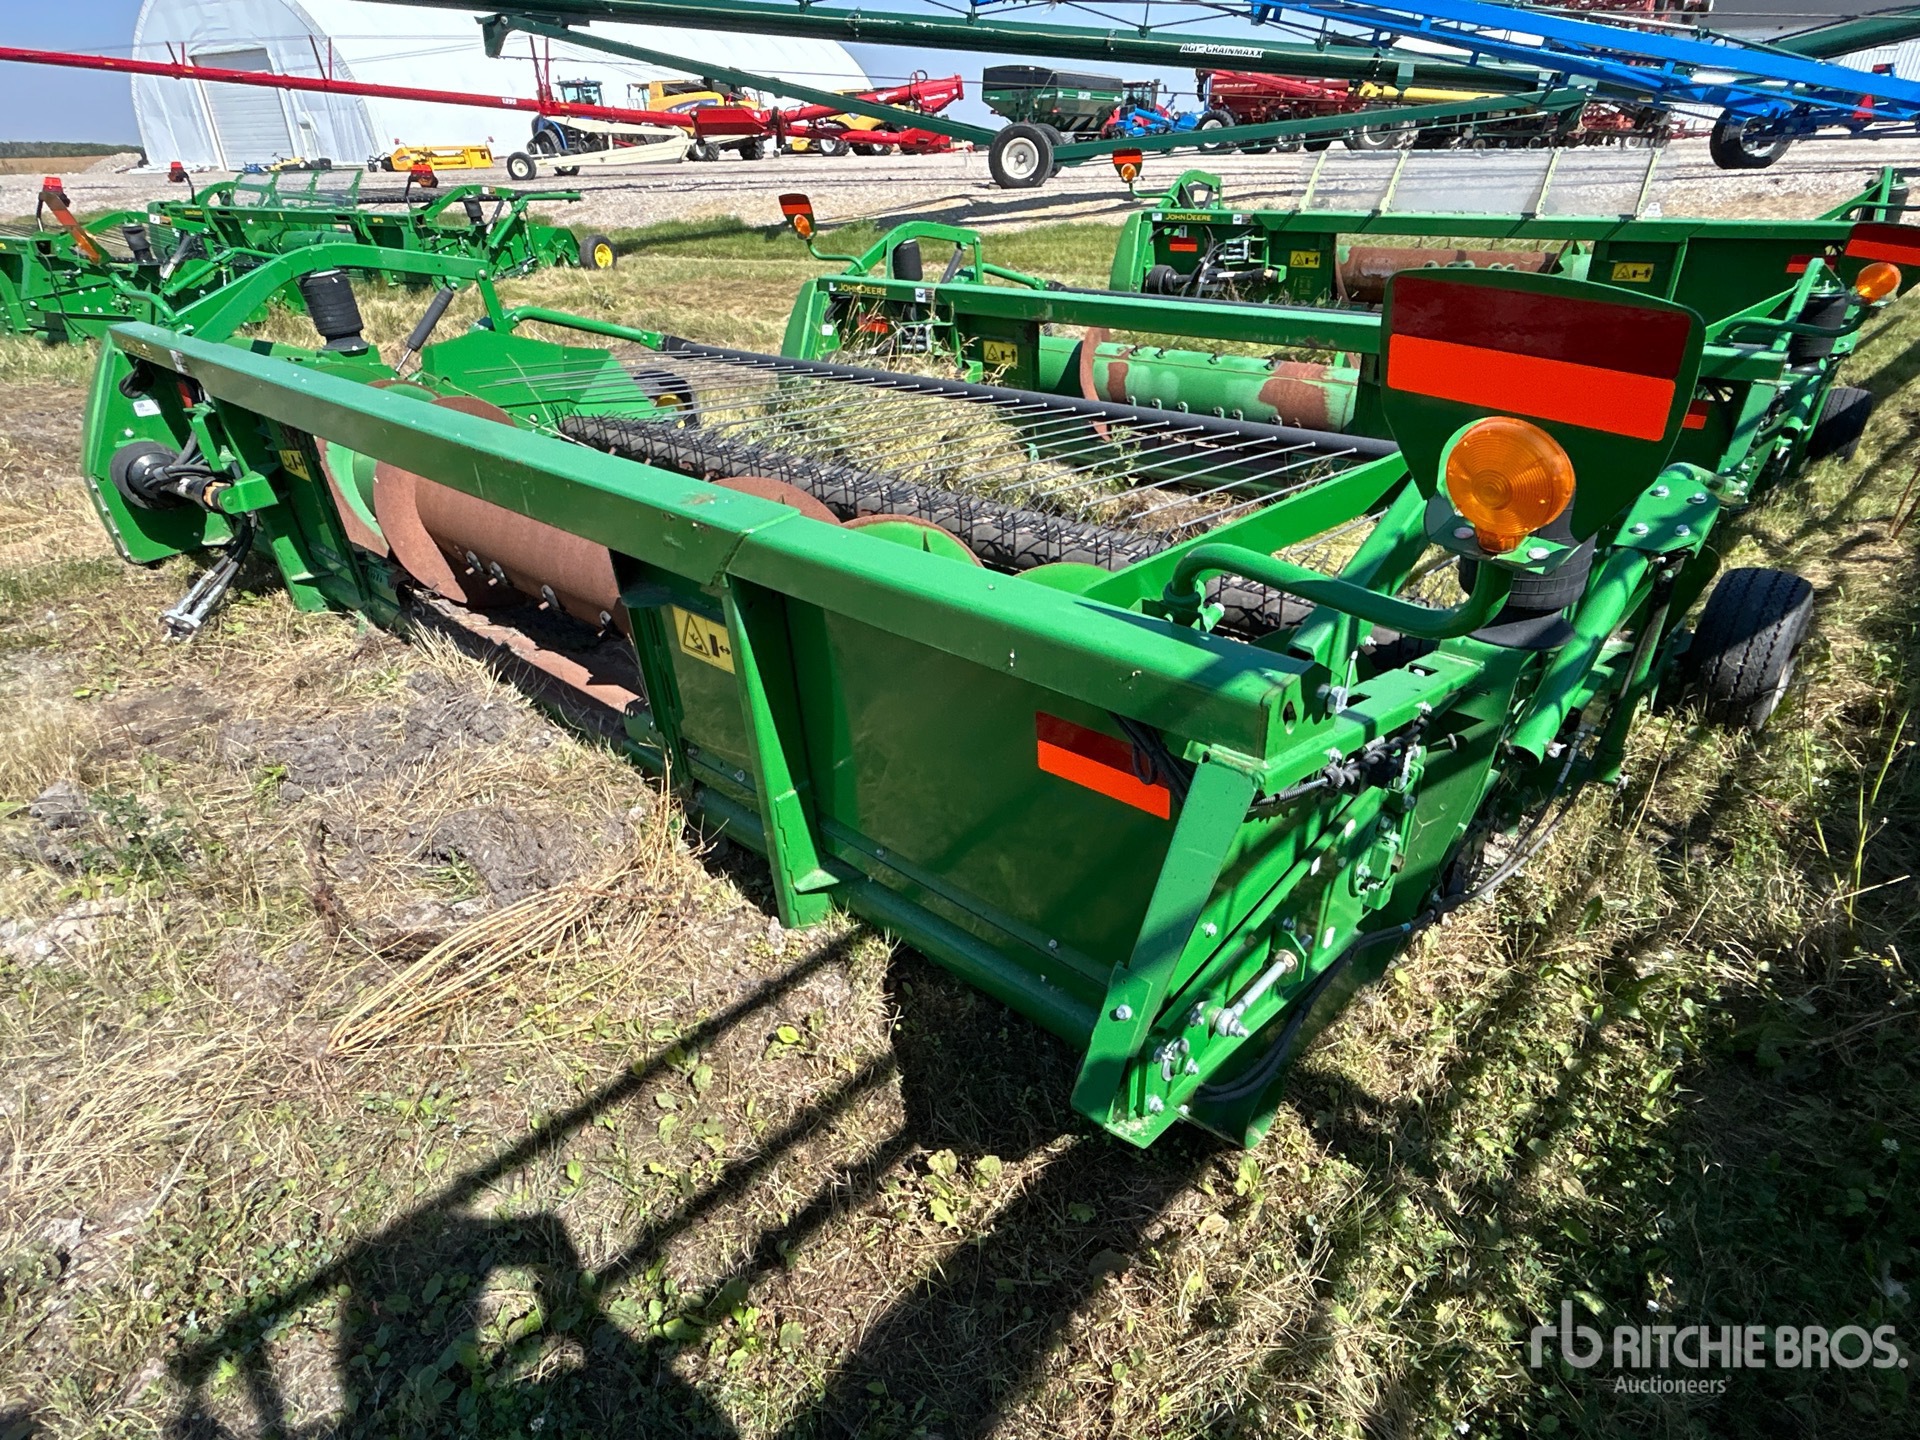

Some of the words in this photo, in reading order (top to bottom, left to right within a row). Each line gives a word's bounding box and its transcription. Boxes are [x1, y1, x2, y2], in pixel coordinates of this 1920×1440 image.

[1205, 44, 1263, 58] GRAINMAXX
[1165, 212, 1186, 221] JOHN
[1186, 212, 1212, 221] DEERE
[839, 283, 858, 293] JOHN
[858, 284, 887, 296] DEERE
